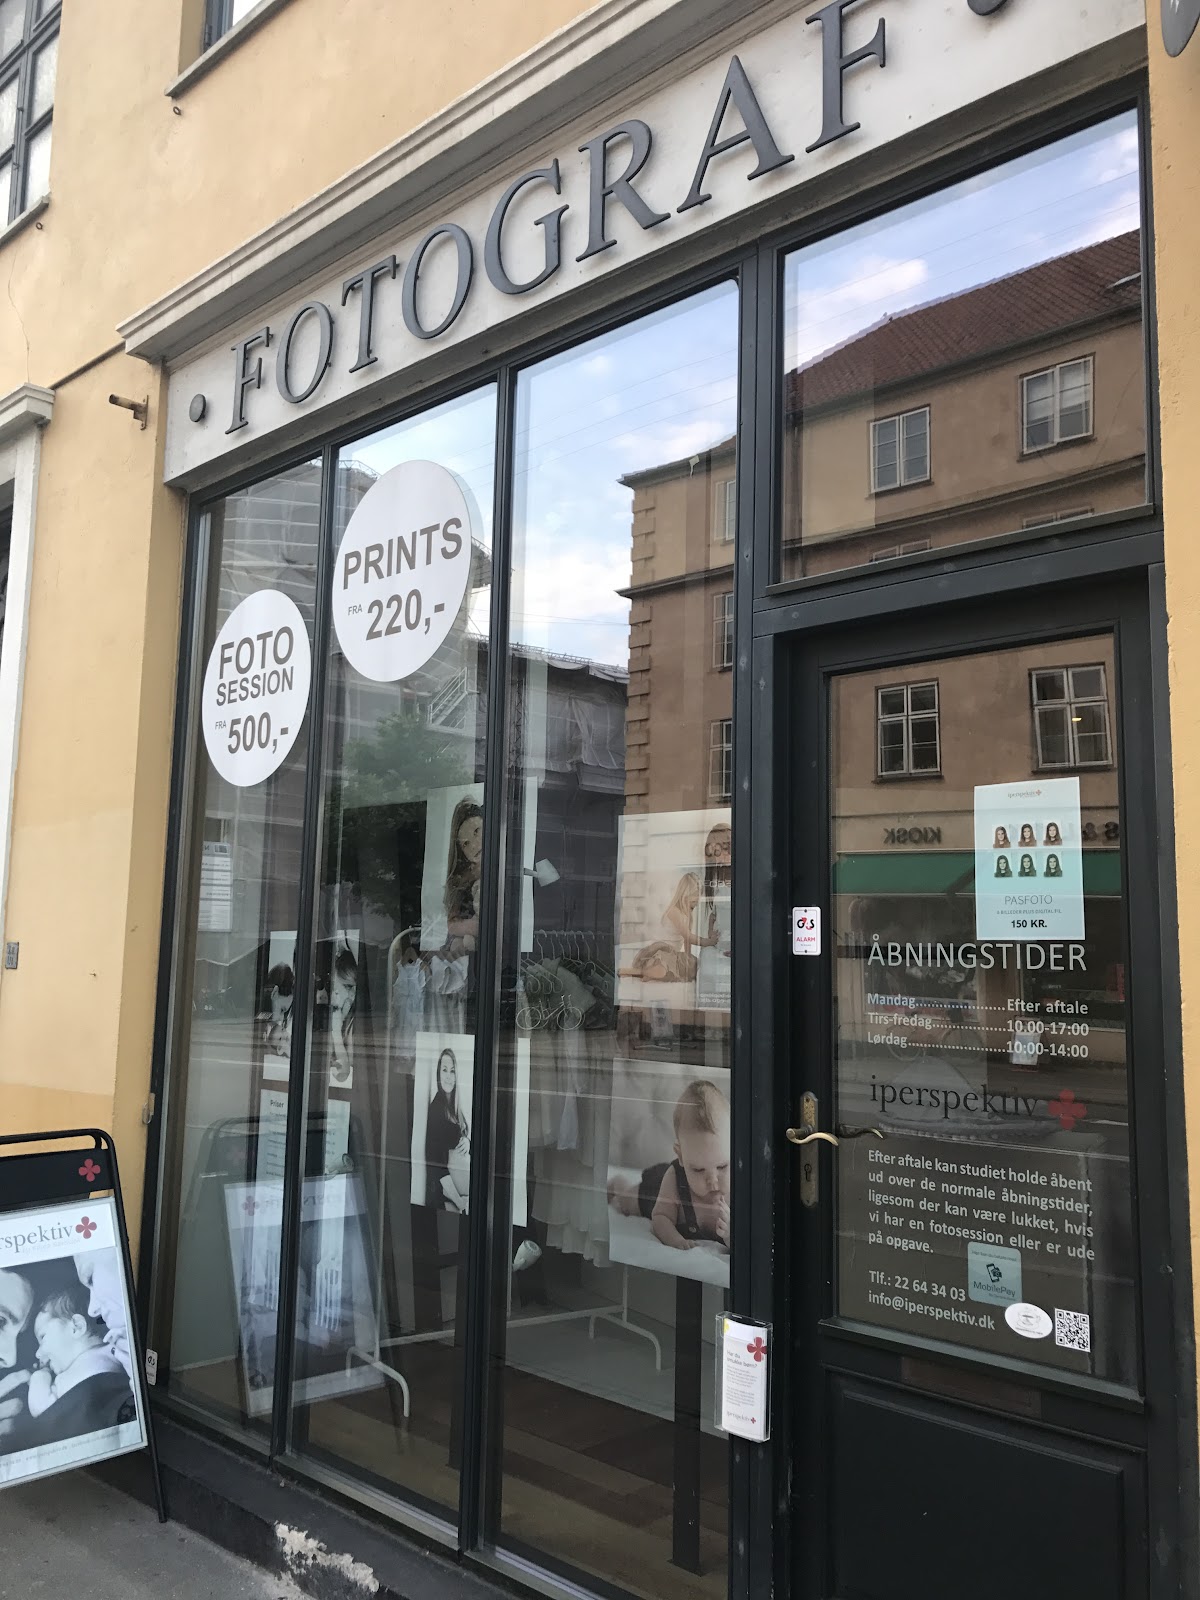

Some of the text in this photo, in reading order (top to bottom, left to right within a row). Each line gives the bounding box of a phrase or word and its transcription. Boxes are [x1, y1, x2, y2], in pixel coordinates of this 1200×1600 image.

[225, 0, 887, 435] FOTOGRAF
[343, 518, 462, 590] PRINTS
[348, 588, 445, 641] FRA 220,-
[219, 625, 294, 680] FOTO
[216, 666, 294, 706] SESSION
[214, 711, 289, 754] FRA 500,-
[1004, 895, 1053, 905] PASFOTO
[1011, 919, 1047, 928] 150 KR.
[868, 933, 1087, 971] ÅBNINGSTIDER
[1045, 1000, 1088, 1014] aftale
[869, 1075, 1040, 1119] iperspektiv
[868, 1149, 1092, 1191] Efter aftale kan studiet holde åbent
[868, 1171, 1093, 1216] ud over de normale åbningstider,
[868, 1189, 1094, 1237] ligesom der kan være lukket, hvis
[868, 1230, 934, 1254] på opgave.
[869, 1210, 1095, 1260] vi har en fotosession eller er ude
[868, 1270, 966, 1302] Tlf.: 22 64 34 03
[973, 1281, 1016, 1298] MobilePay
[868, 1290, 995, 1330] info@iperspektiv.dk
